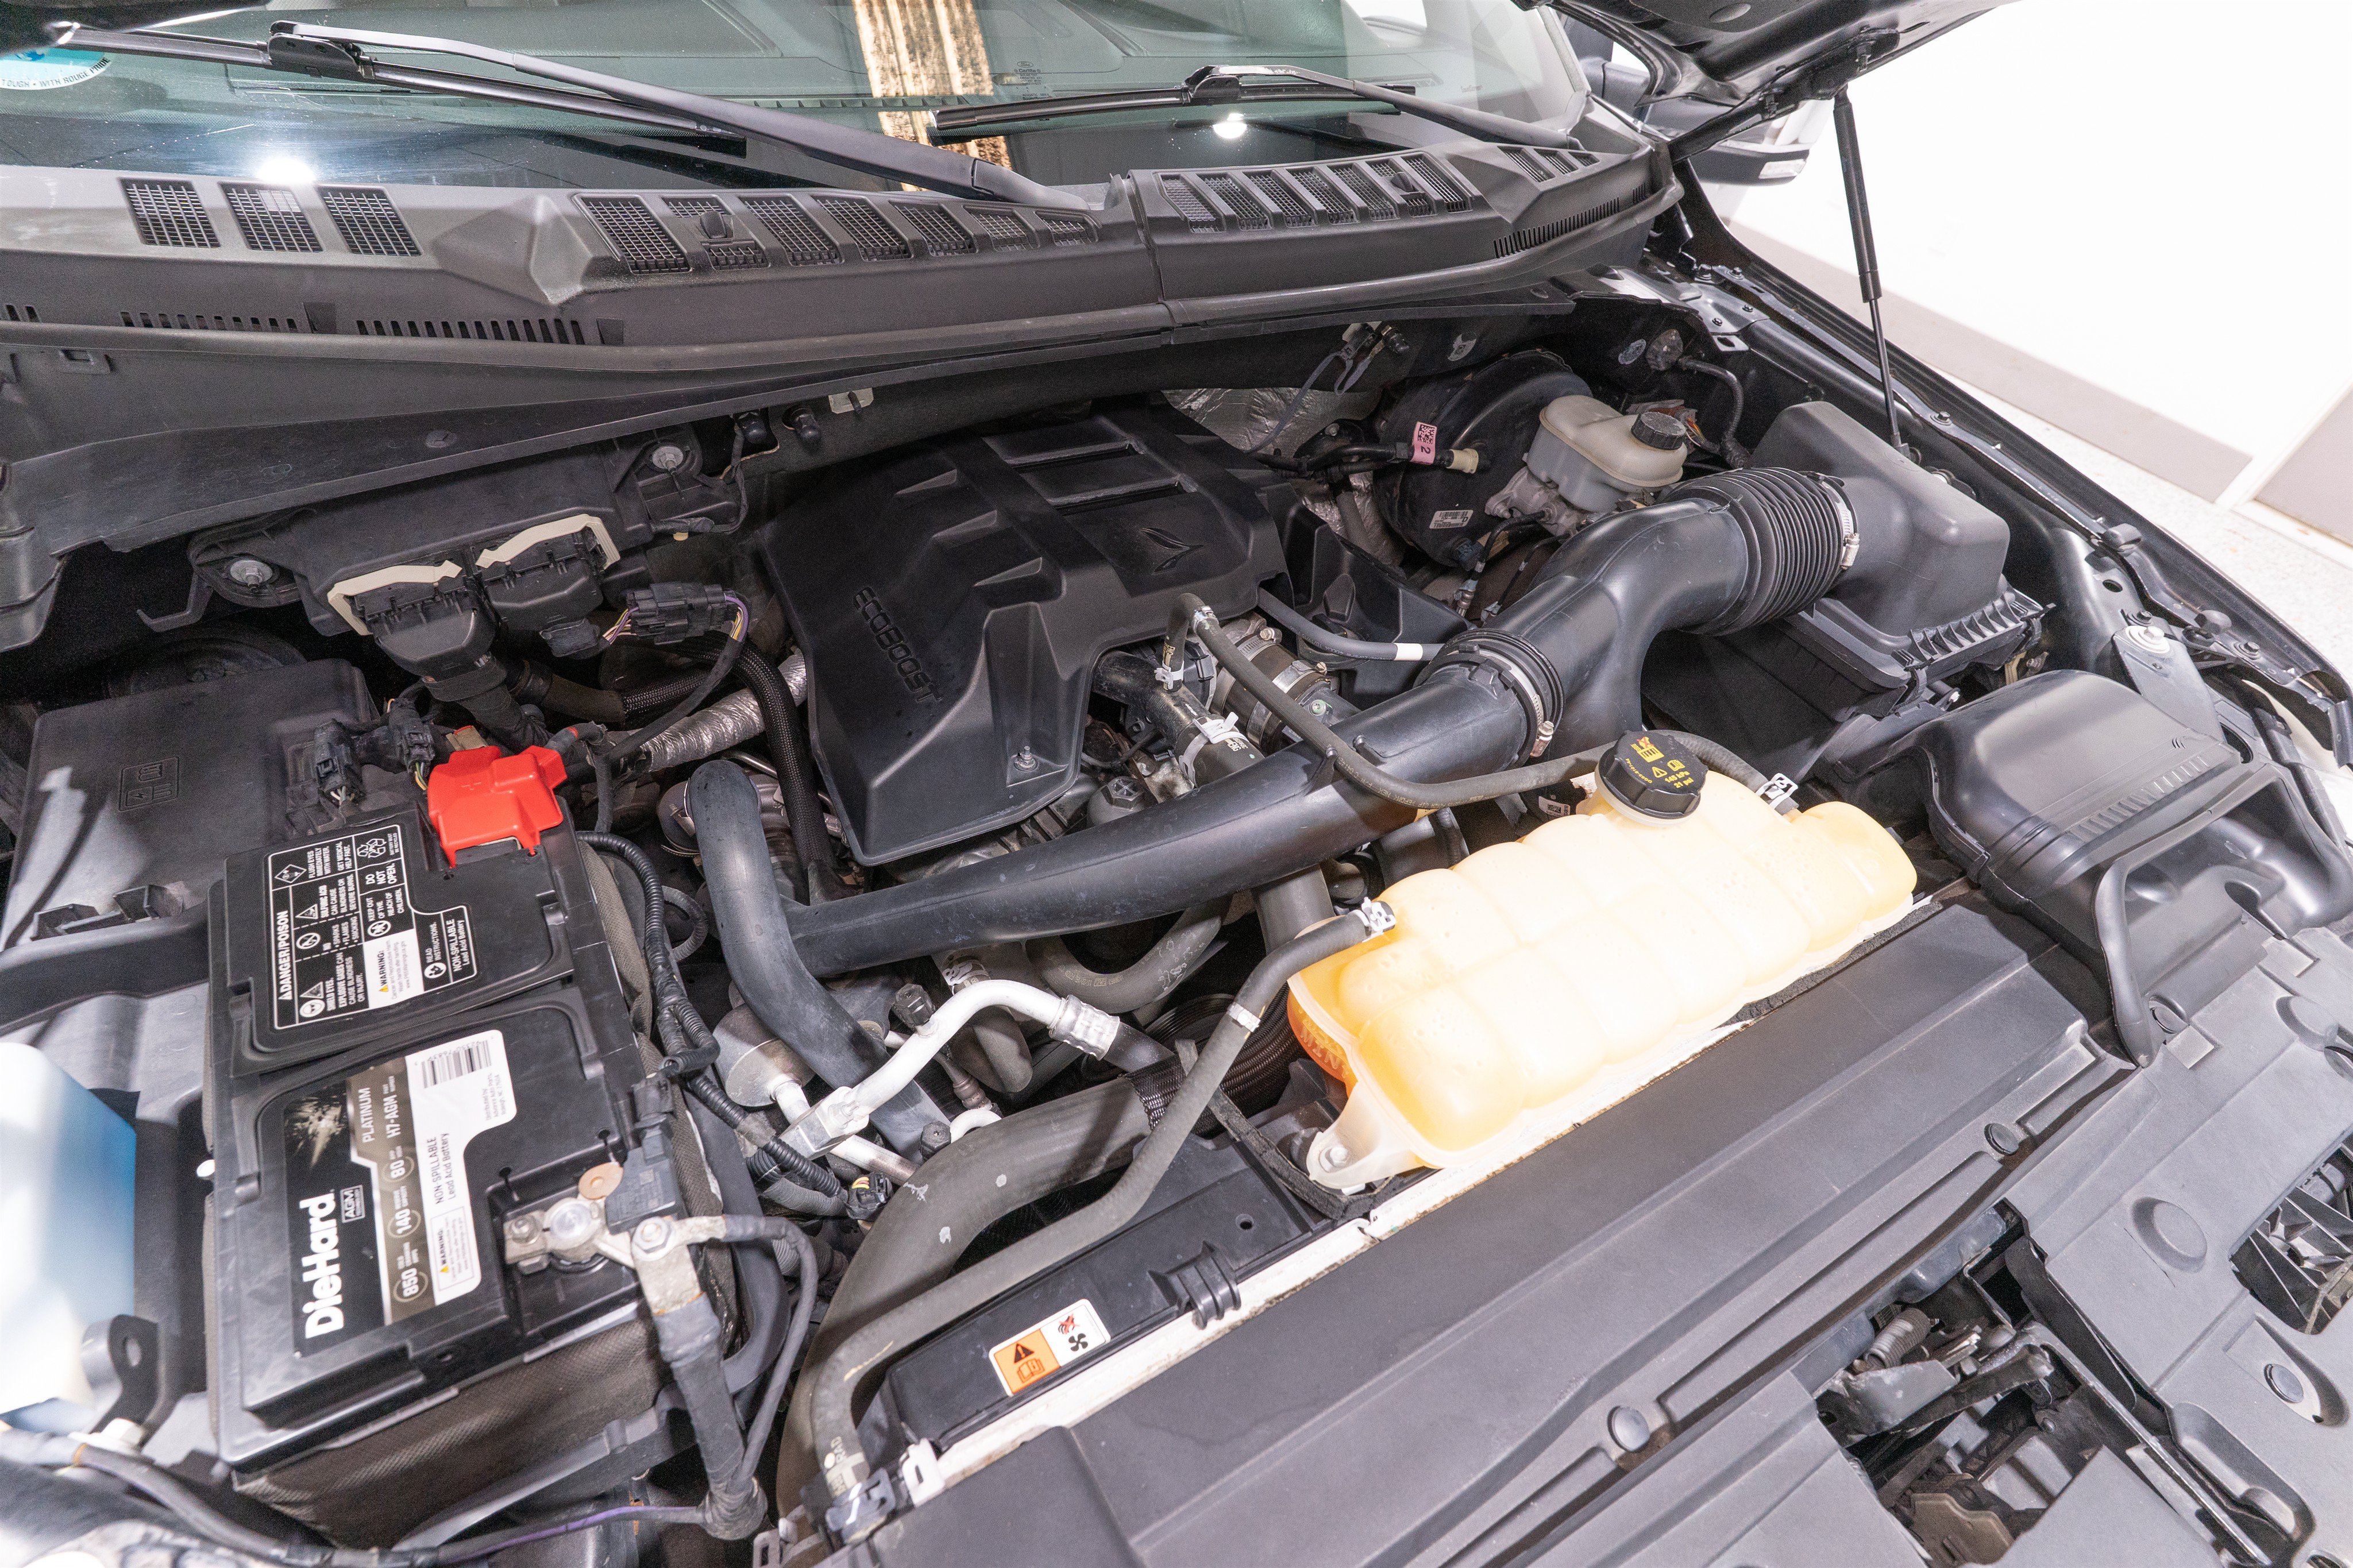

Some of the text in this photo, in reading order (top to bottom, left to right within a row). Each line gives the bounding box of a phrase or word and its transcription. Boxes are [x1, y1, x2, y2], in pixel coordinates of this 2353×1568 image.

[40, 79, 60, 87] WITH
[63, 72, 90, 83] ROUGE
[90, 57, 111, 74] PRIDE
[1421, 445, 1431, 454] 2
[854, 586, 942, 702] ECOBOOST
[1665, 771, 1691, 783] 145 kPa
[1683, 777, 1694, 786] psi
[315, 847, 323, 876] IMMEDIATELY
[335, 841, 344, 861] MEDICAL
[365, 873, 375, 885] DO
[376, 869, 386, 885] NOT
[385, 863, 397, 884] OPEN.
[319, 885, 329, 918] SULFURIC ACID
[329, 887, 337, 905] CAUSE
[338, 878, 347, 913] BLINDNESS OR
[346, 873, 356, 910] SEVERE BURNS.
[385, 891, 395, 916] REACH OF
[394, 887, 404, 913] CHILDREN.
[367, 907, 375, 921] KEEP
[376, 900, 385, 919] OF THE
[332, 924, 341, 945] SPARKS
[341, 921, 350, 942] FLAMES
[350, 916, 359, 939] SMOKING
[429, 921, 442, 961] INSTRUCTIONS.
[455, 918, 470, 965] Lead Acid Battery
[277, 910, 292, 994] DANGER/POISON
[323, 942, 331, 951] NO
[425, 947, 434, 963] READ
[450, 918, 462, 972] NON-SPILLABLE
[335, 952, 347, 1007] EXPLOSIVE GASES CAN
[345, 956, 356, 1005] CAUSE BLINDNESS
[377, 950, 387, 986] WARNING:
[325, 977, 335, 1011] SHIELD EYES.
[356, 972, 365, 1002] OR INJURY.
[357, 1085, 375, 1144] PLATINUM
[383, 1093, 401, 1139] H7-AGM
[389, 1158, 405, 1179] 80
[427, 1136, 444, 1204] NON-SPILLABLE
[439, 1131, 456, 1200] Lead Acid Battery
[343, 1188, 356, 1220] AGM
[394, 1207, 412, 1235] 140
[299, 1191, 344, 1339] DieHard
[401, 1266, 419, 1297] 850
